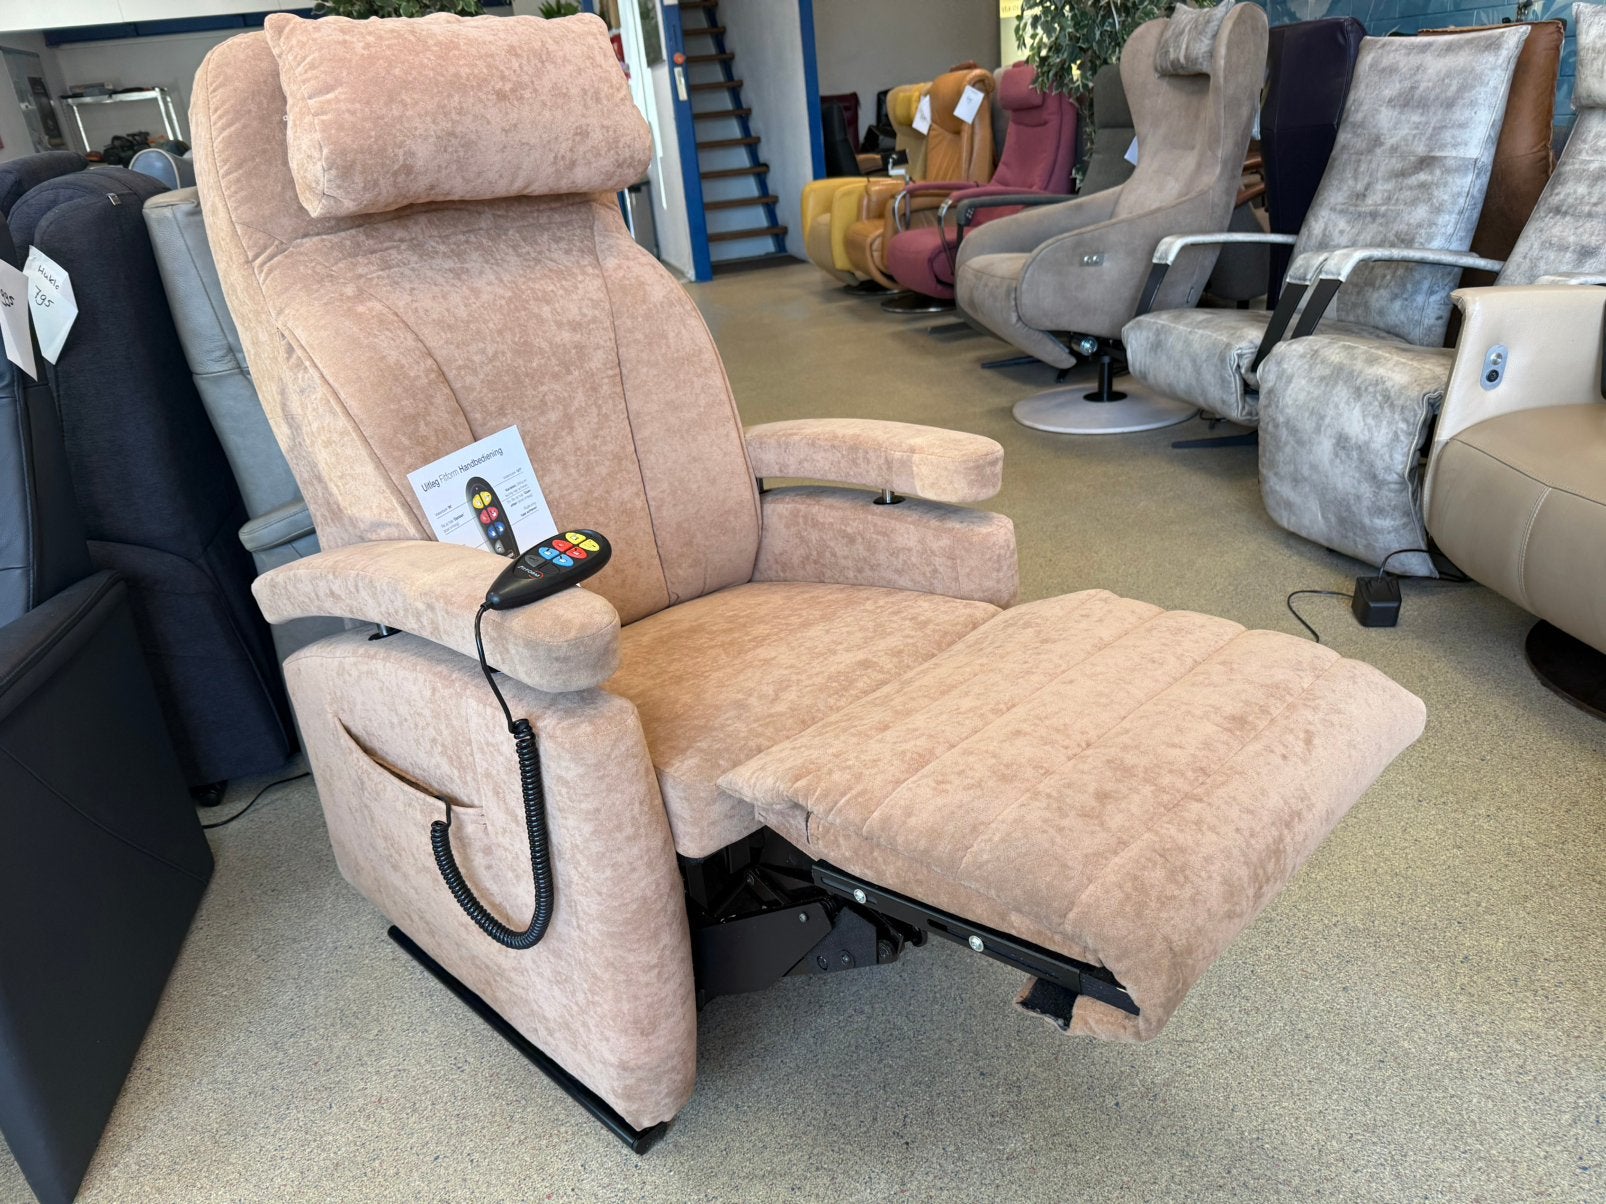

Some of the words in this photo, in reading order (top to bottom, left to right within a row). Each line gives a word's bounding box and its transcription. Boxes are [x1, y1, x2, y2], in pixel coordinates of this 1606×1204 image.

[34, 284, 55, 308] 795
[421, 479, 440, 492] Uitleg
[458, 447, 504, 474] Handbediening
